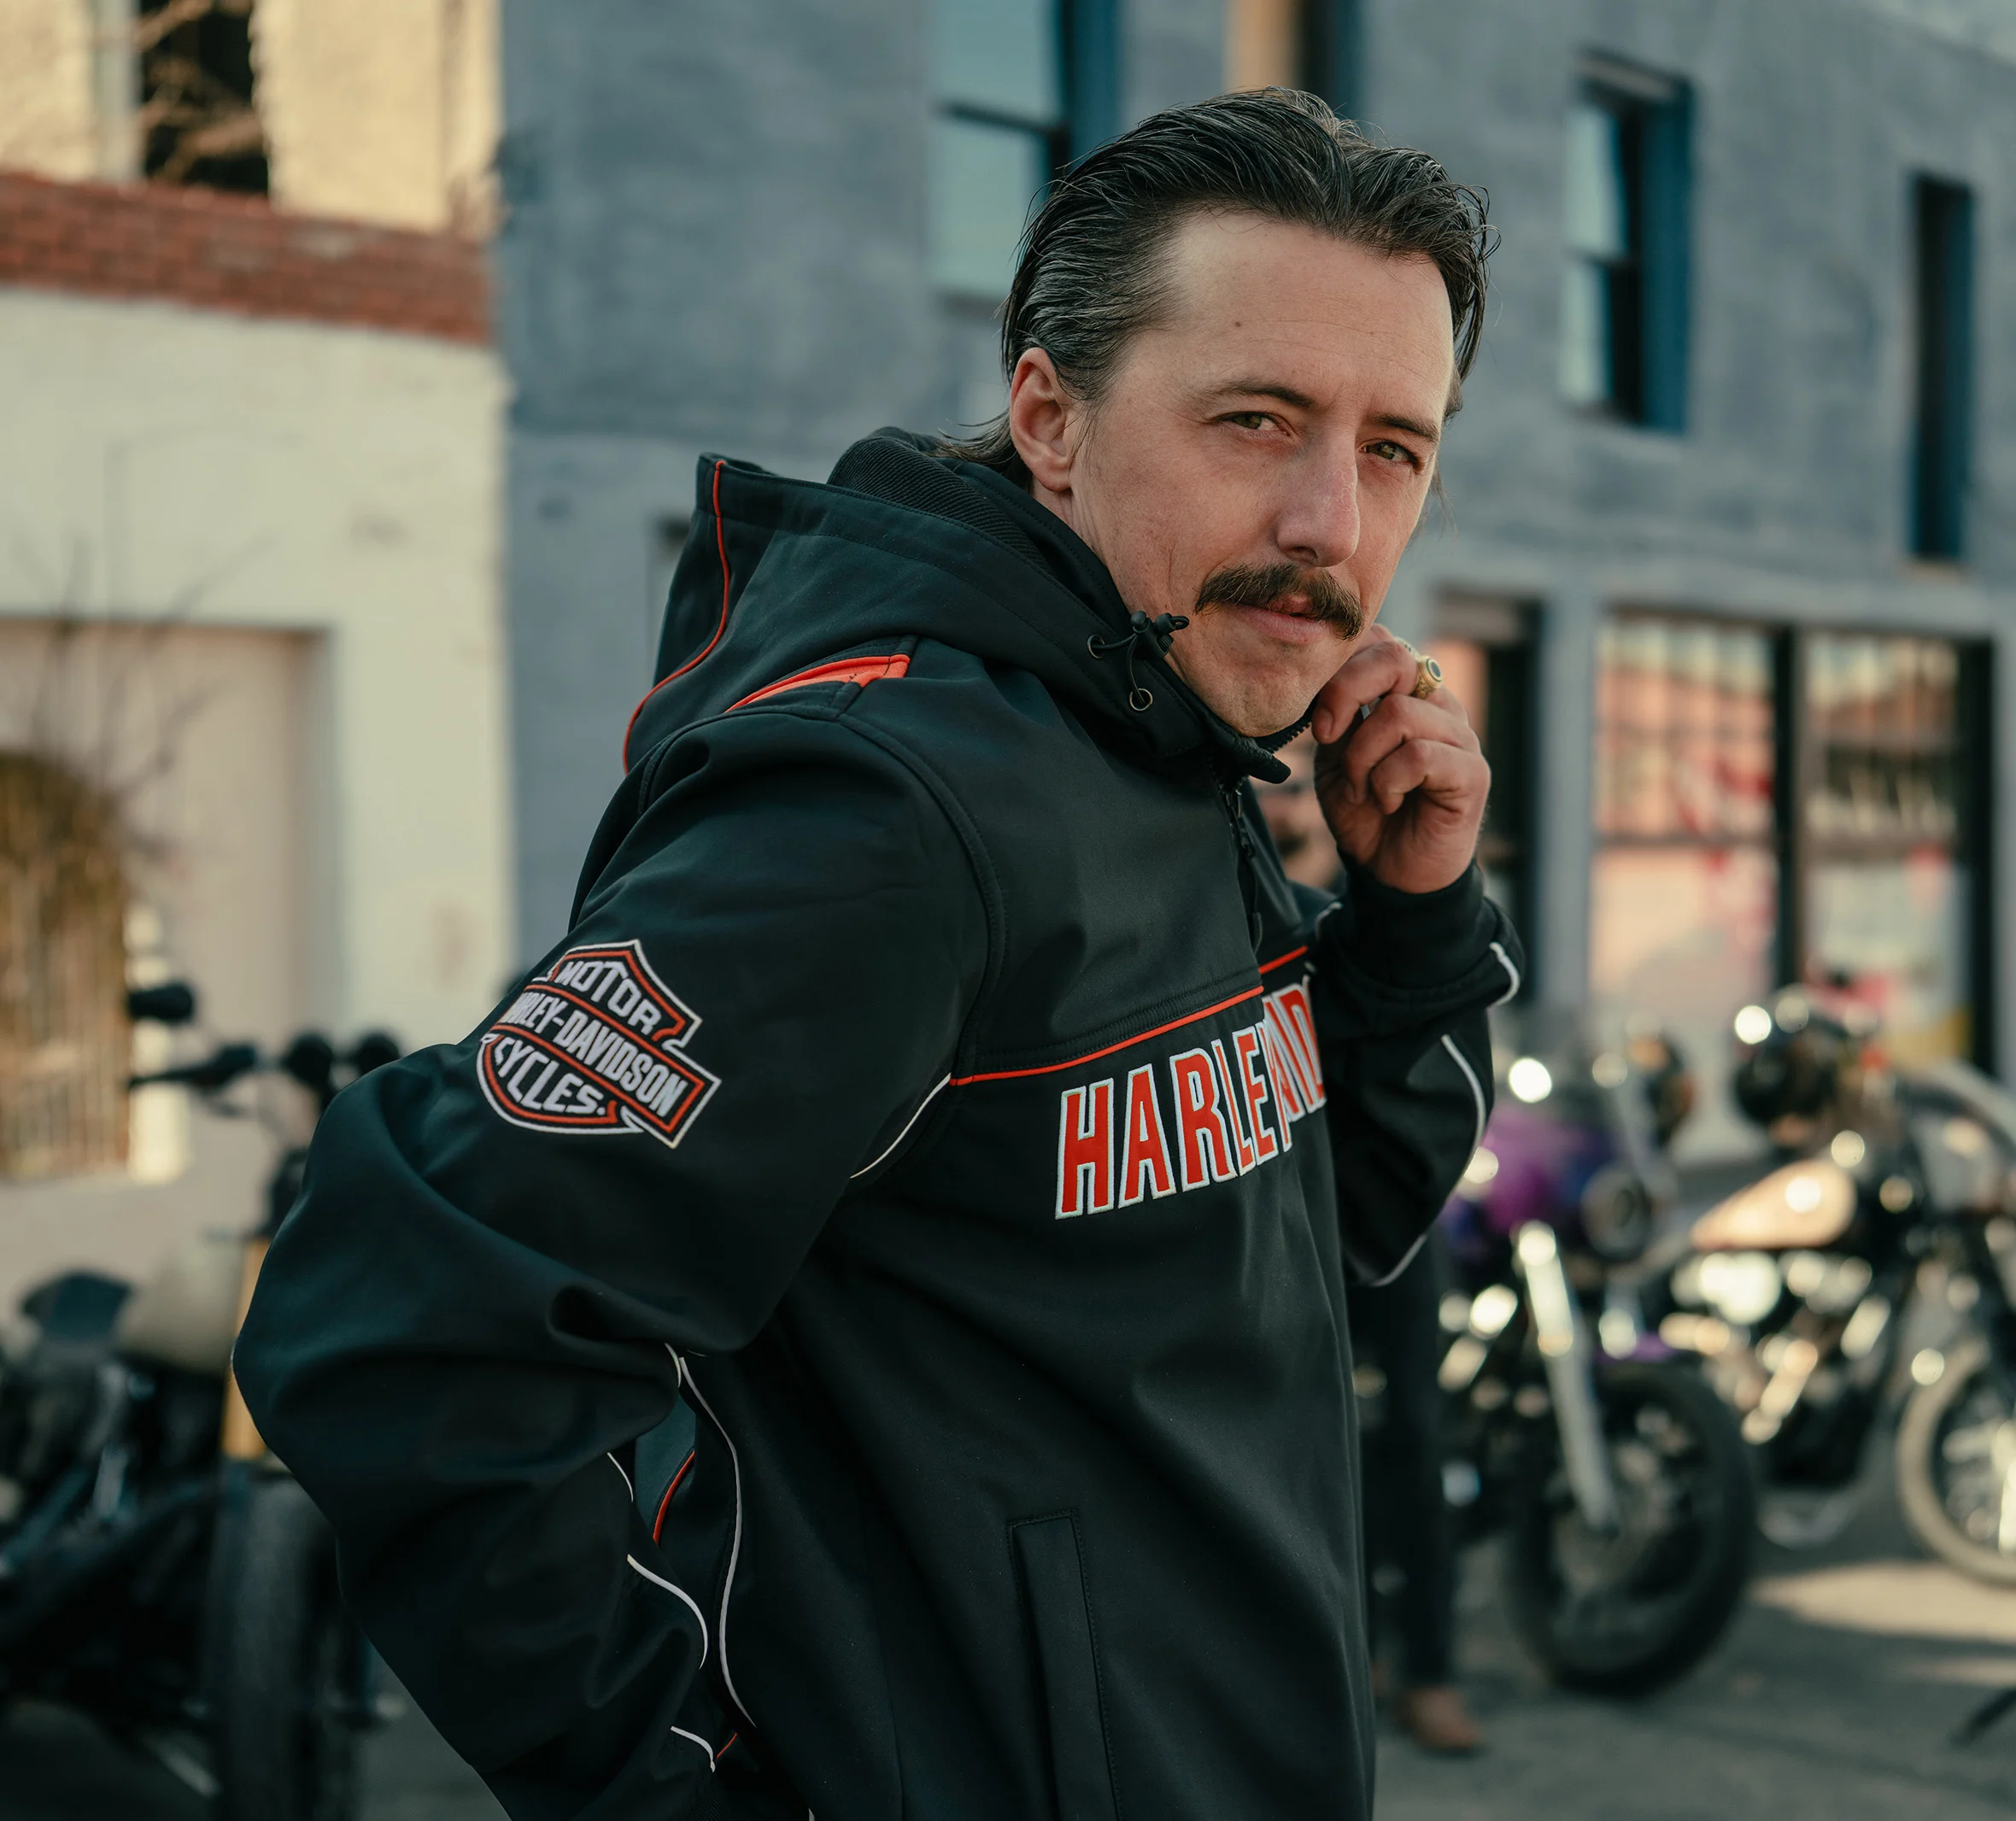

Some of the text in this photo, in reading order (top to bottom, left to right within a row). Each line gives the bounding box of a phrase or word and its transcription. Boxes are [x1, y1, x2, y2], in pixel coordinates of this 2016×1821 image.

[495, 992, 688, 1117] ARLEY-DAVIDSON
[554, 961, 661, 1035] MOTOR
[1055, 1021, 1292, 1220] HARLEY
